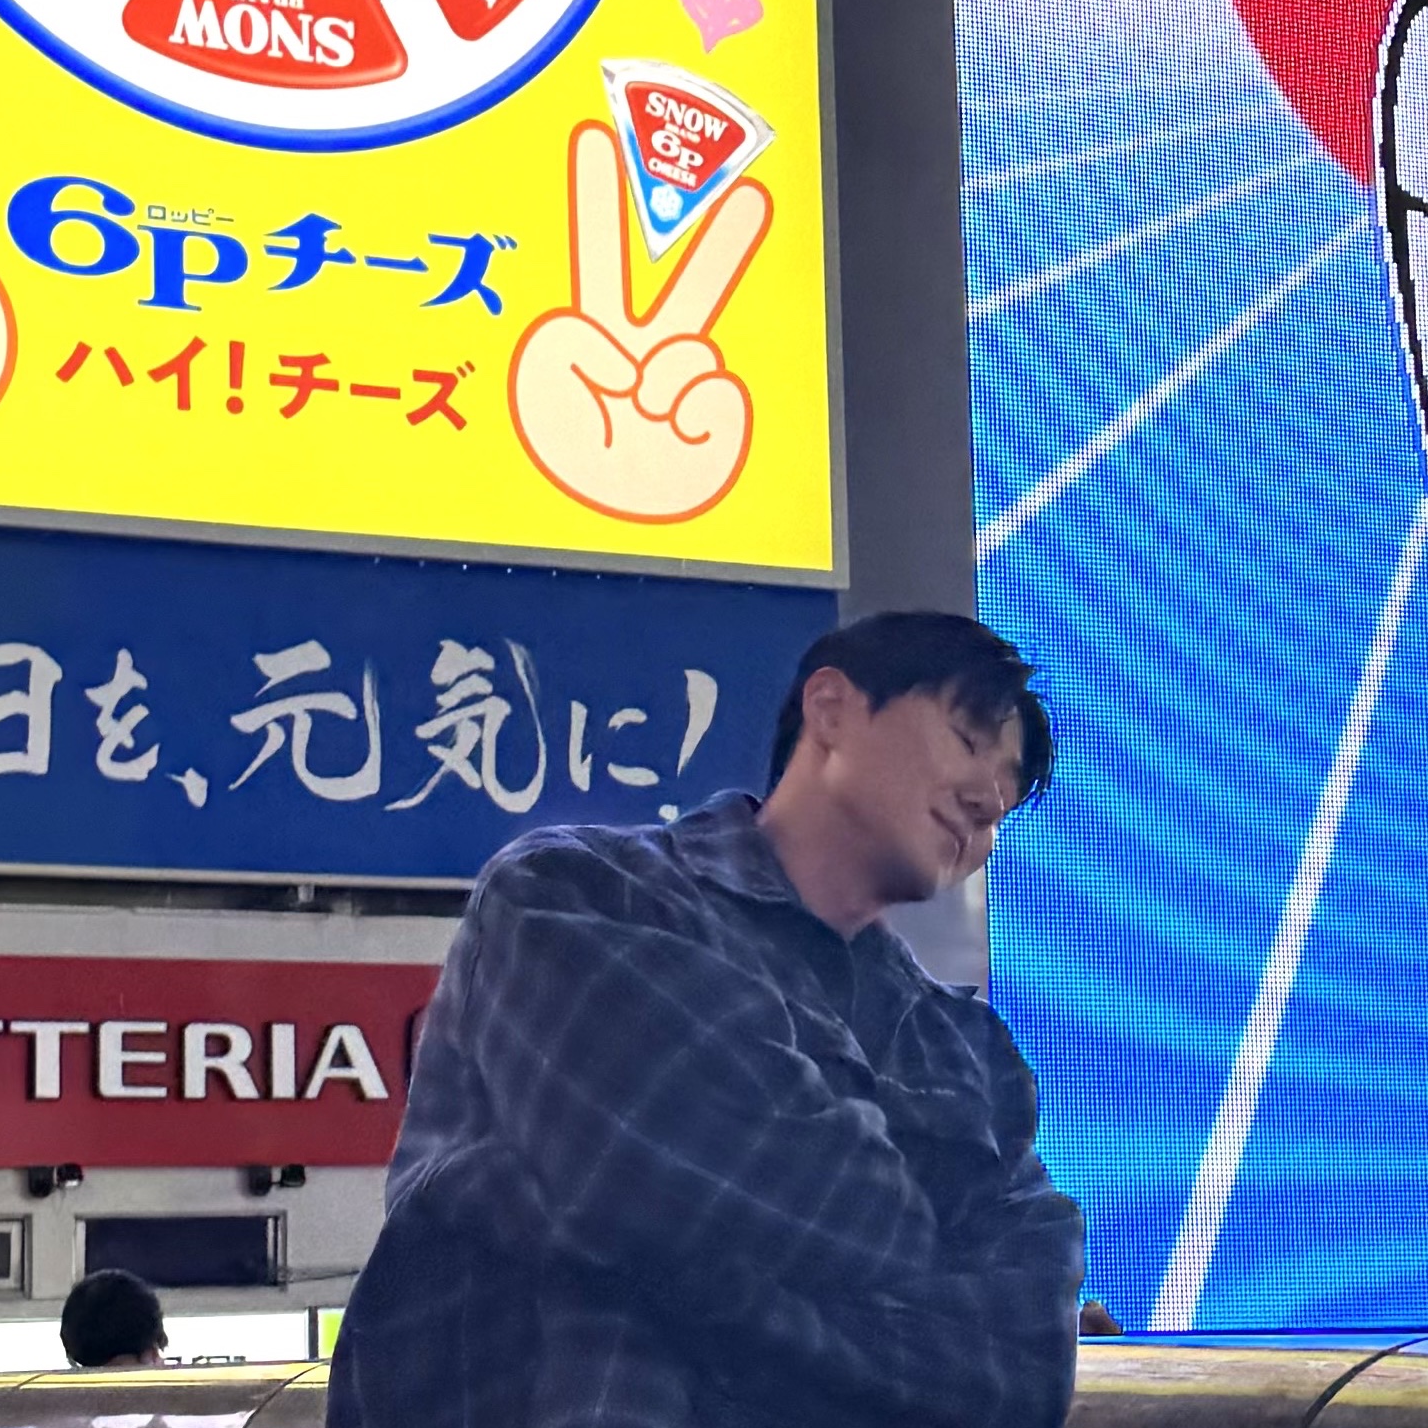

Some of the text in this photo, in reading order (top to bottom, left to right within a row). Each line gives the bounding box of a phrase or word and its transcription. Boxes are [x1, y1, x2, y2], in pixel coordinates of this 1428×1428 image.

[168, 0, 357, 68] SNOW
[645, 91, 728, 142] SNOW
[55, 335, 476, 431] ハイ!チーズ
